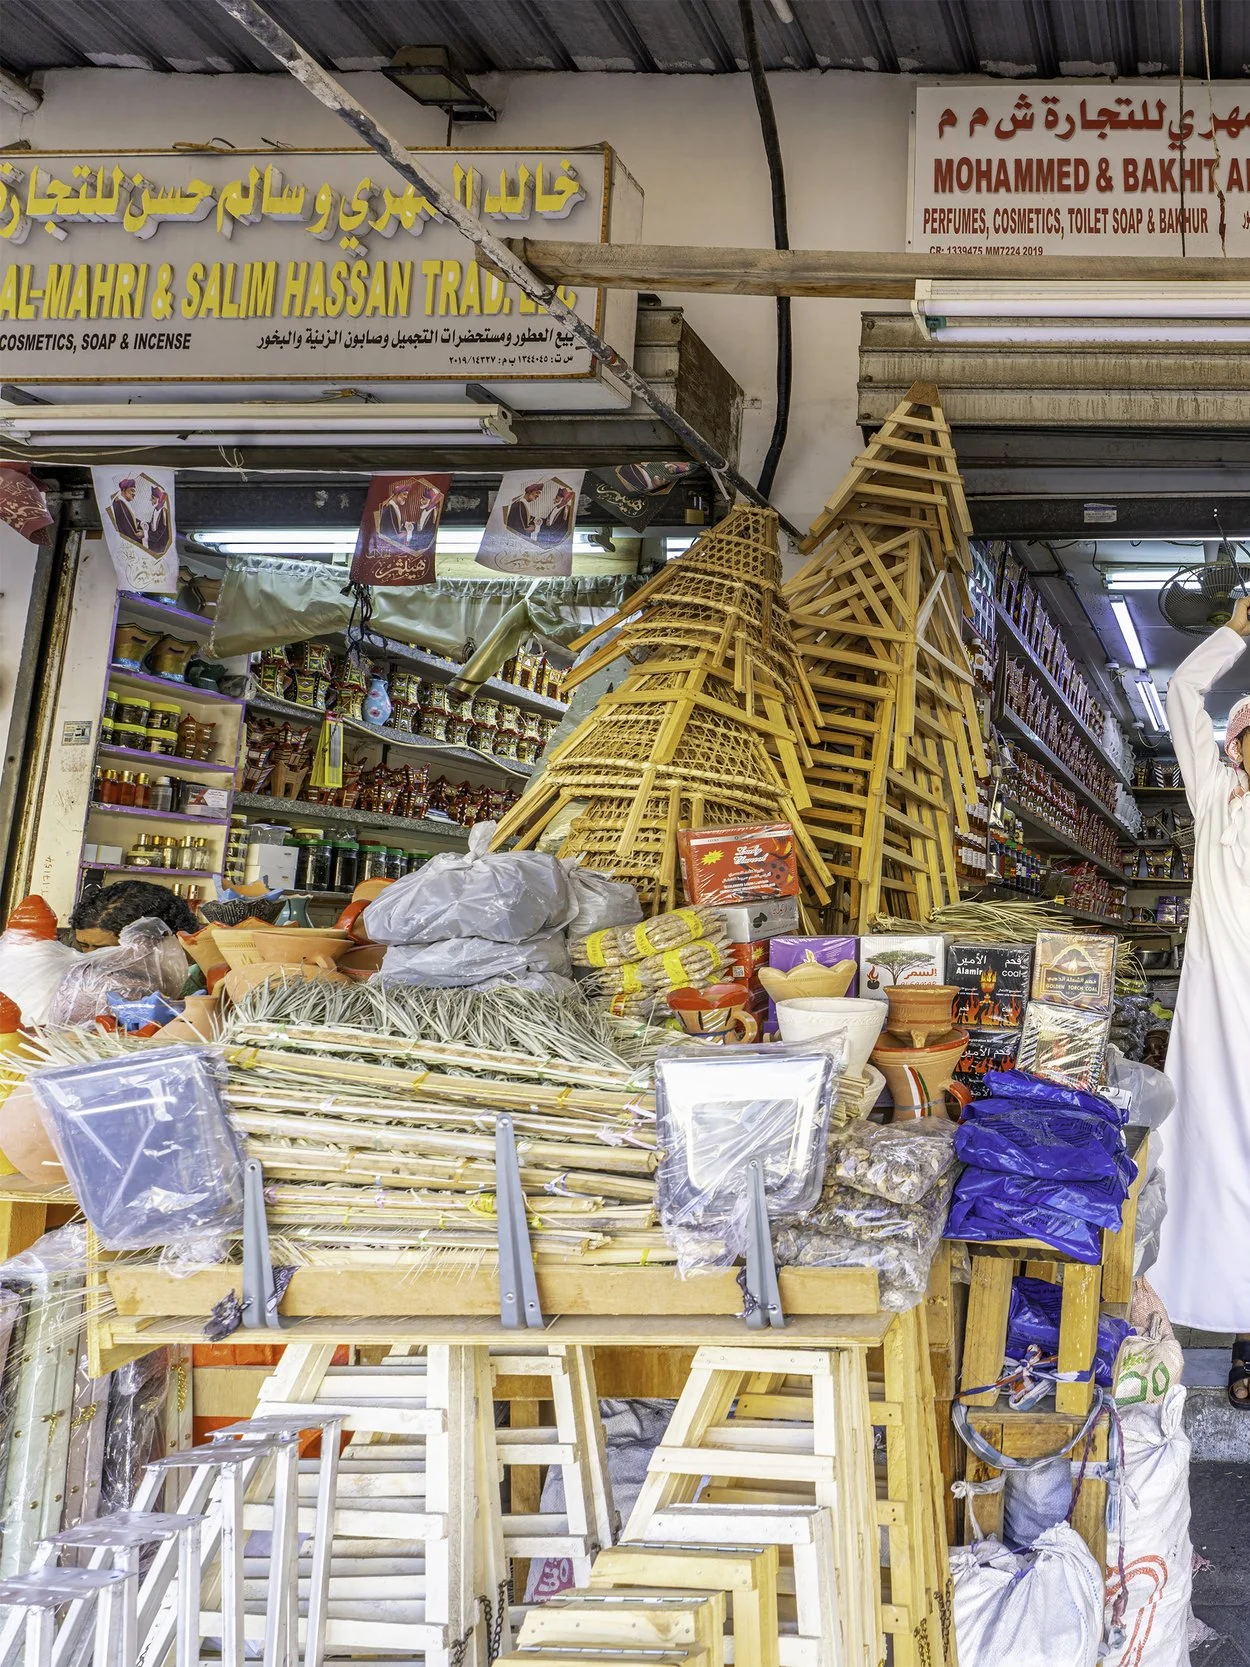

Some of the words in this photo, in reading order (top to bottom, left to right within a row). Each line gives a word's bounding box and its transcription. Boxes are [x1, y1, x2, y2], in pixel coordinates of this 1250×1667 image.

[938, 108, 958, 139] م
[969, 107, 990, 139] م
[995, 93, 1035, 140] ش
[1042, 95, 1167, 140] للتجارة
[484, 159, 582, 215] خالد
[933, 157, 1090, 194] MOHAMMED
[1096, 156, 1114, 193] &
[1123, 157, 1219, 194] BAKHIT
[123, 172, 215, 233] حسن
[216, 163, 307, 234] سالم
[305, 182, 332, 234] و
[923, 207, 989, 240] PERFUMES,
[993, 207, 1064, 240] COSMETICS,
[1068, 207, 1109, 234] TOILET
[1112, 207, 1143, 234] SOAP
[1147, 208, 1155, 233] &
[1159, 207, 1209, 234] BAKHUR
[946, 246, 983, 256] 1339475
[985, 246, 1021, 256] MM7224
[1022, 246, 1043, 256] 2019
[0, 262, 149, 321] AL-MAHRI
[150, 262, 174, 321] &
[180, 260, 279, 320] SALIM
[281, 260, 413, 318] HASSAN
[0, 333, 76, 354] COSMETICS,
[81, 333, 117, 350] SOAP
[120, 333, 129, 350] &
[133, 333, 192, 350] INCENSE
[256, 330, 303, 350] والبخور
[343, 329, 389, 351] وصابون
[391, 328, 438, 351] التجميل
[956, 967, 982, 975] Alamir
[957, 953, 987, 966] الأمير
[1005, 955, 1022, 968] فحم
[960, 1045, 991, 1058] الأمير
